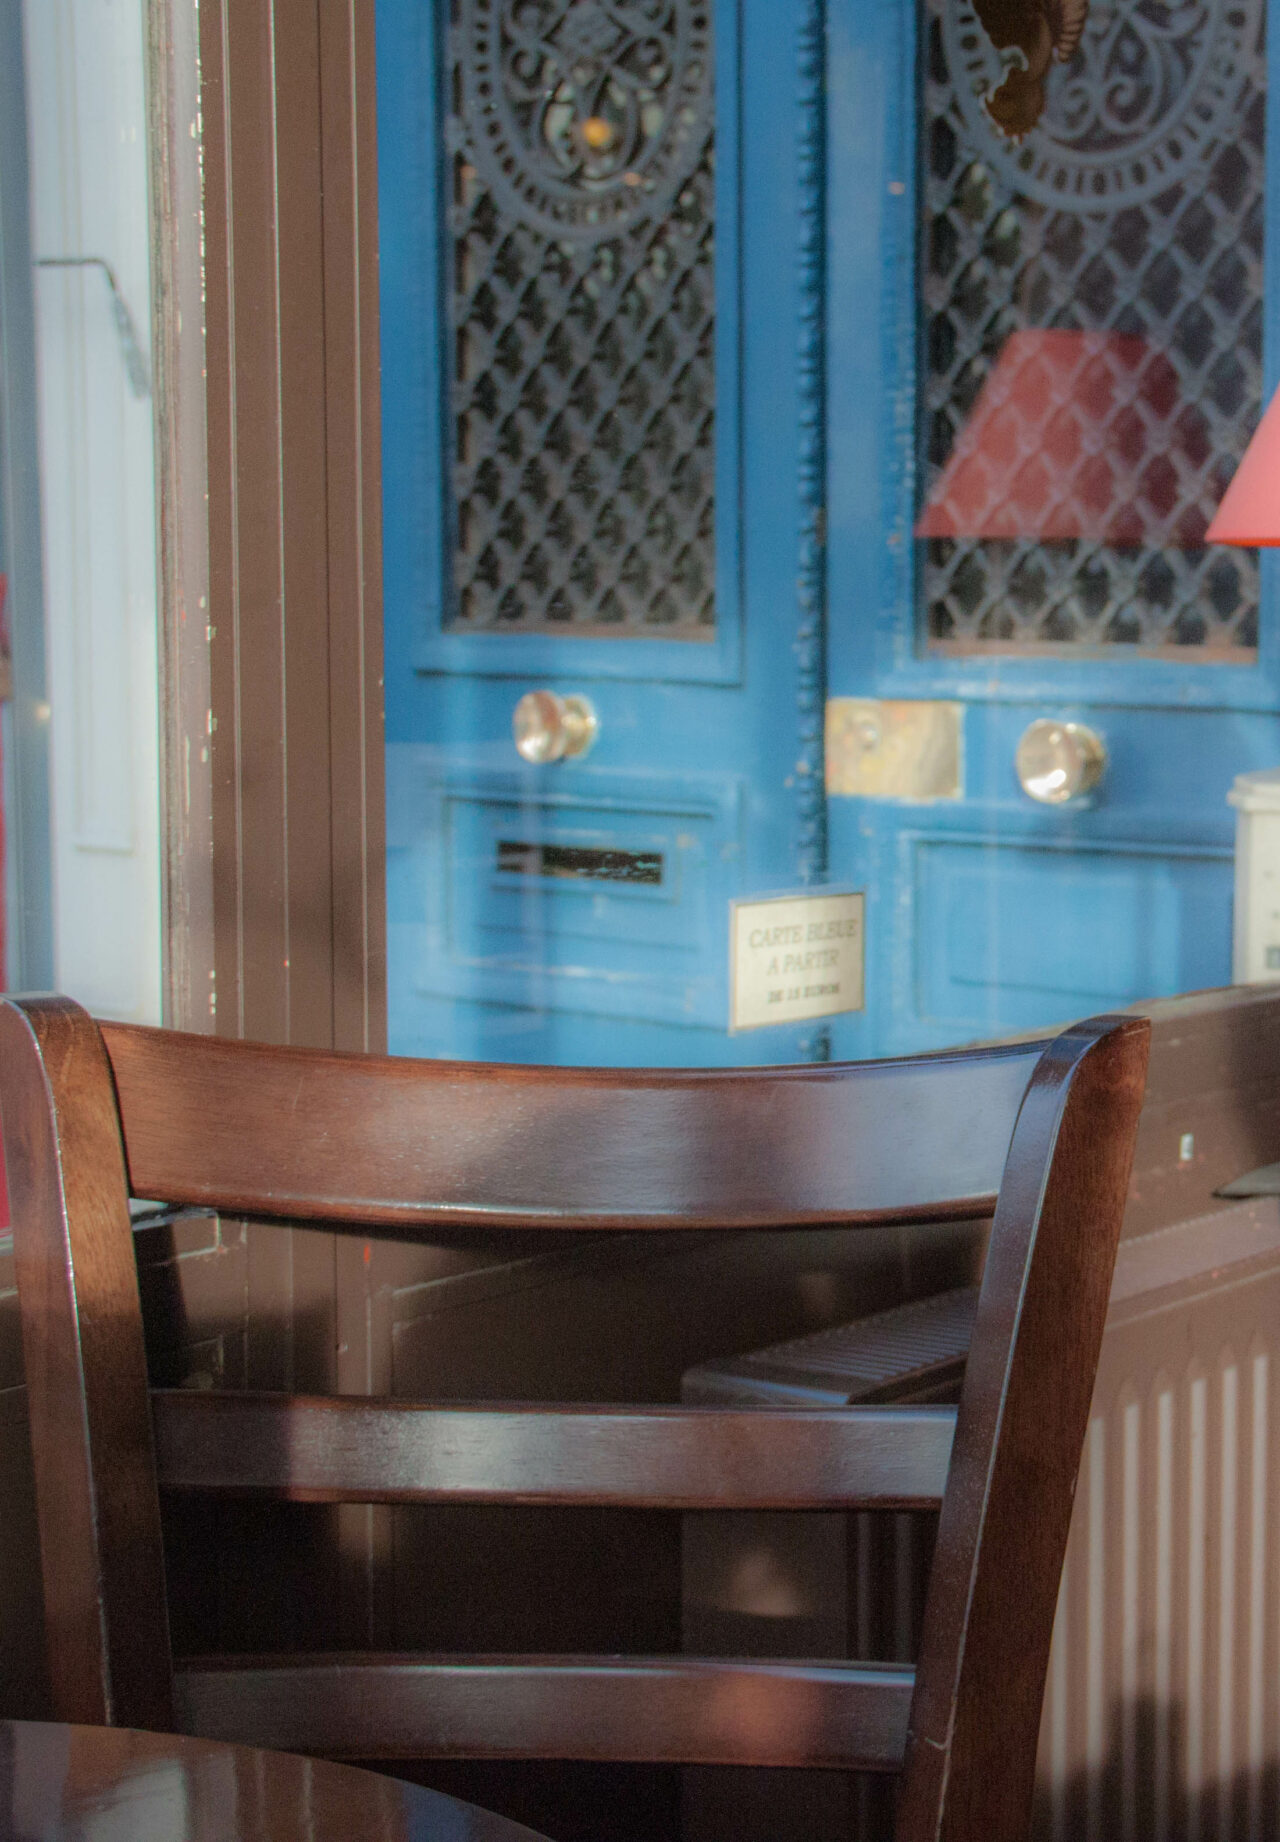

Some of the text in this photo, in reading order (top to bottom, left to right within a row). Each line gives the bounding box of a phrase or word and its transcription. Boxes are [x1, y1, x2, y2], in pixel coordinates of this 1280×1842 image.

[749, 919, 857, 949] CARTE BLEUE
[783, 950, 839, 973] PARTIR
